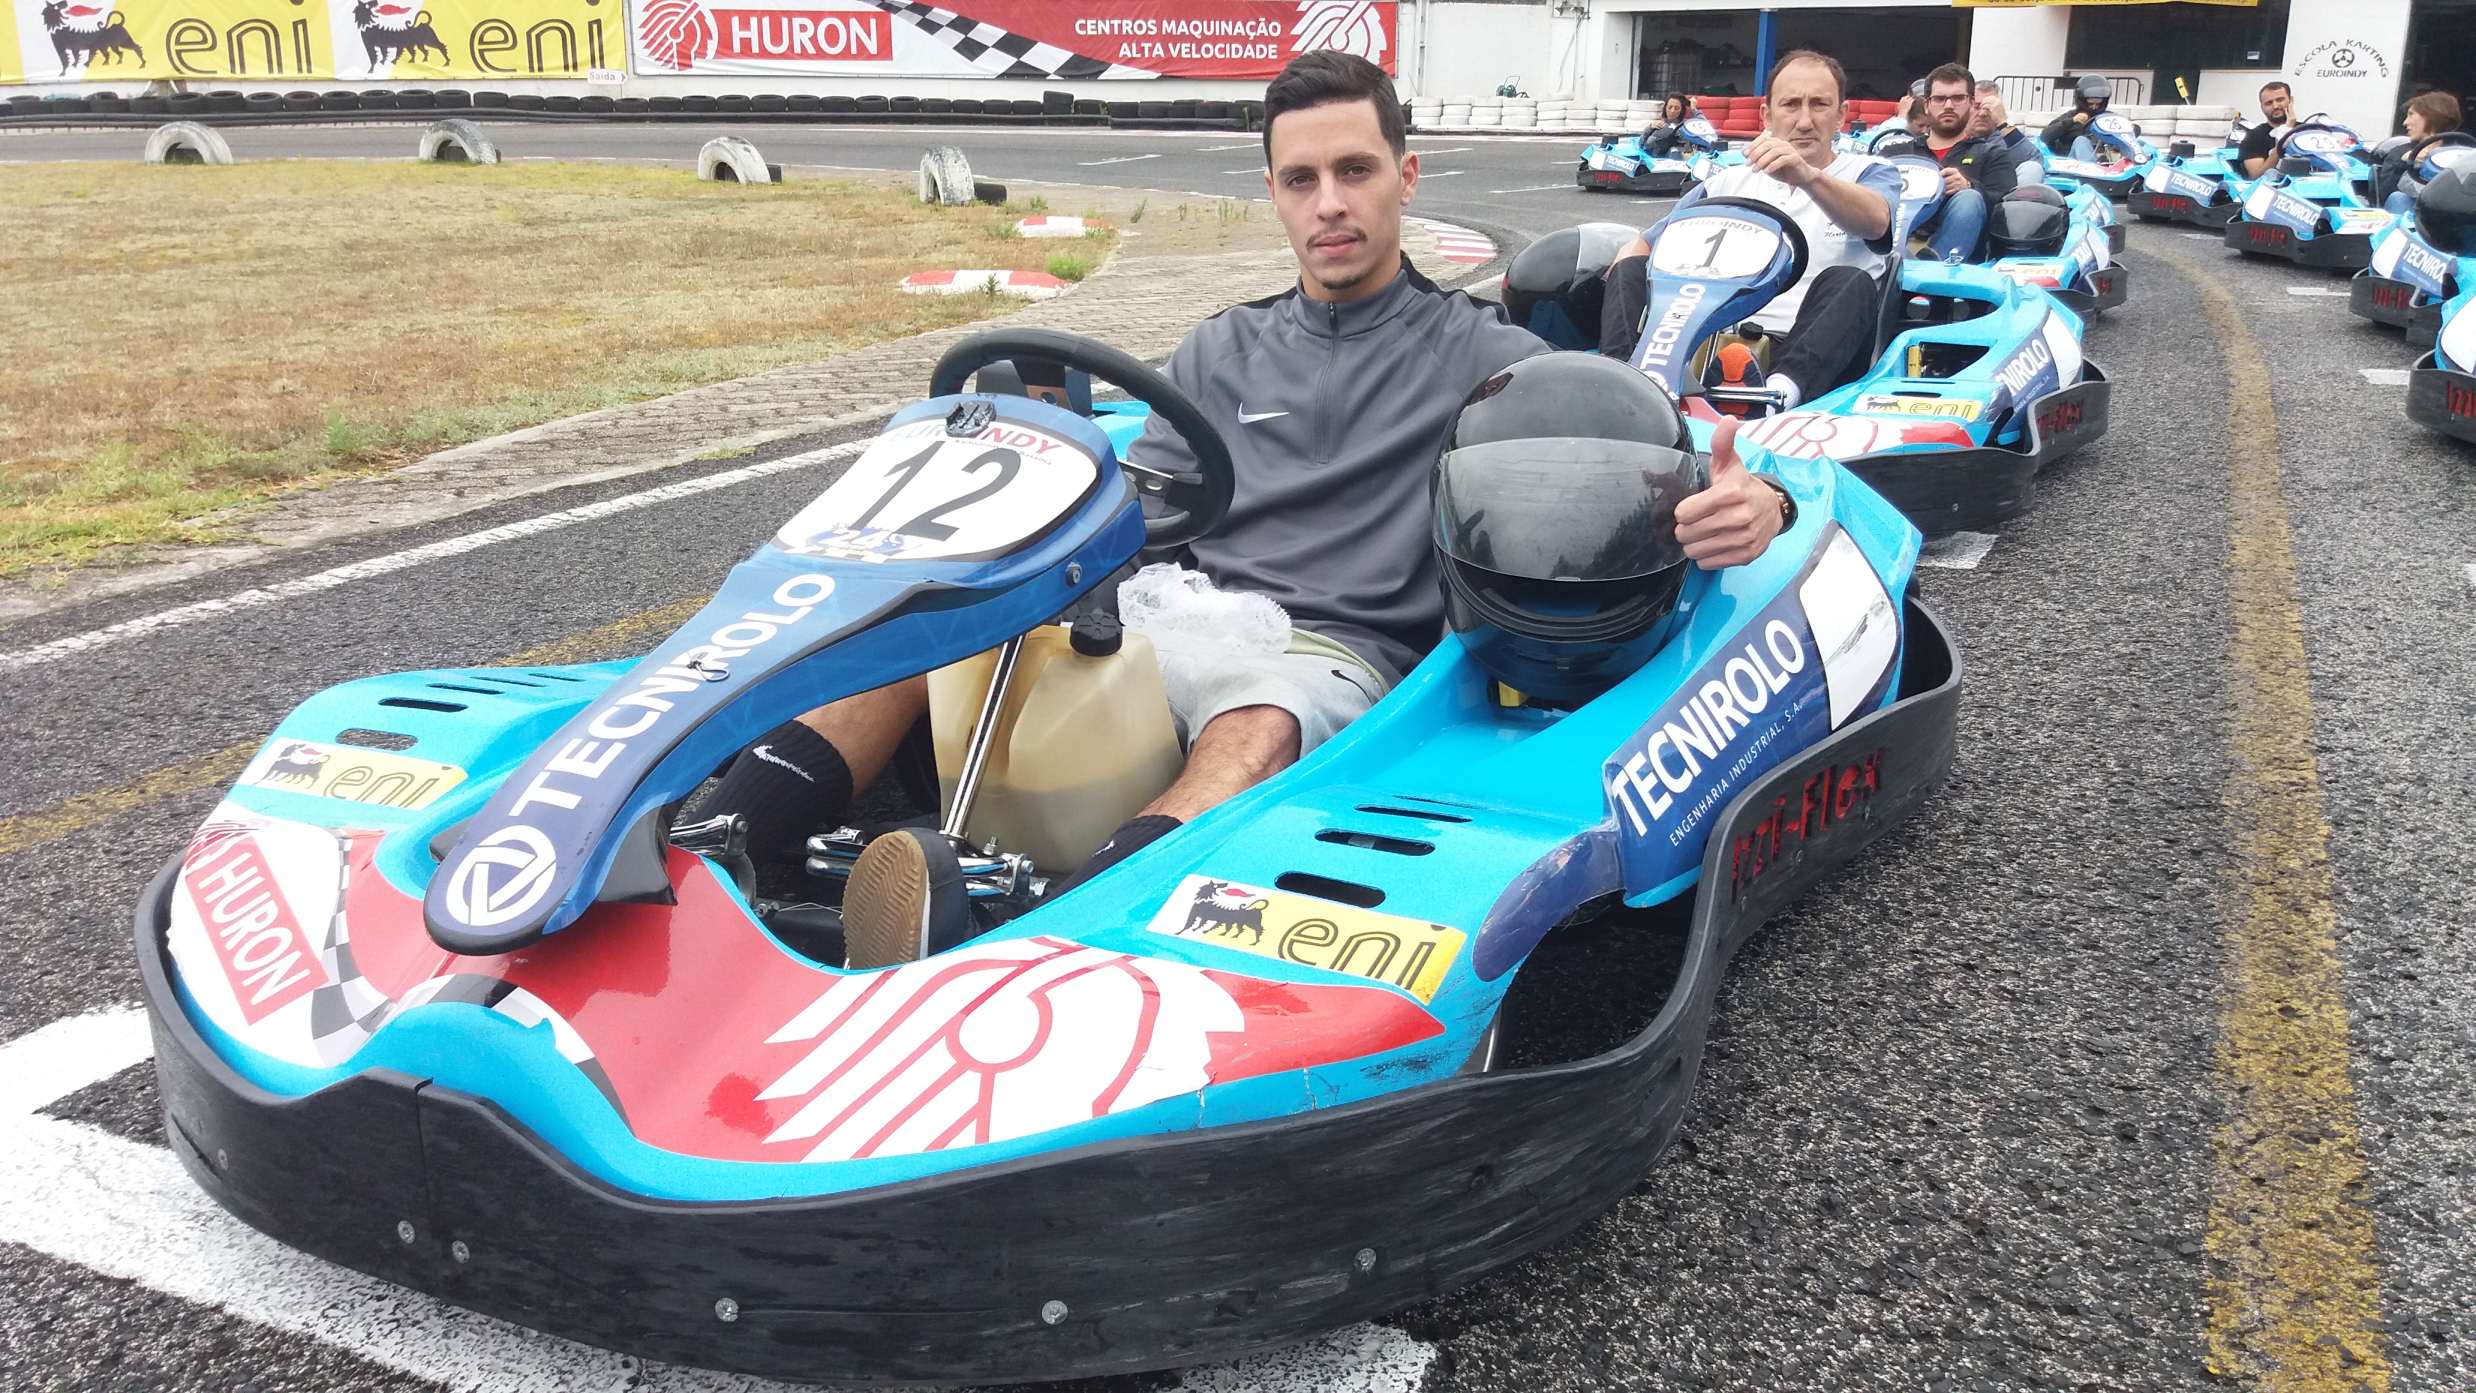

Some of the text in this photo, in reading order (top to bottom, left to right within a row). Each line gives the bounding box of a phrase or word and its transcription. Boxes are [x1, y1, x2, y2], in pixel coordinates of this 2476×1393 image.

[165, 0, 313, 75] eni
[469, 0, 605, 73] eni
[731, 16, 878, 55] HURON
[1075, 18, 1282, 40] CENTROS MAQUINAÇÃO
[1119, 43, 1278, 59] ALTA VELOCIDADE
[2345, 39, 2389, 78] KARTING
[2316, 69, 2368, 78] EUROINDY
[2272, 194, 2321, 226] TECNIROLO
[1703, 228, 1728, 268] 1
[2403, 243, 2447, 284] TECNIRO
[1640, 283, 1706, 369] TECNIROLO
[1995, 338, 2049, 397] NIROLO
[1908, 401, 1973, 420] eni
[889, 424, 1063, 455] EURNDY
[883, 441, 1022, 542] 12
[508, 573, 836, 818] TECNIROLO
[1611, 619, 1805, 837] TECNIROLO
[323, 766, 454, 808] eni
[1669, 780, 1729, 847] ENGENHARIA
[1729, 722, 1786, 781] INDUSTRIAL,
[198, 852, 311, 1006] HURON
[1278, 918, 1447, 990] eni
